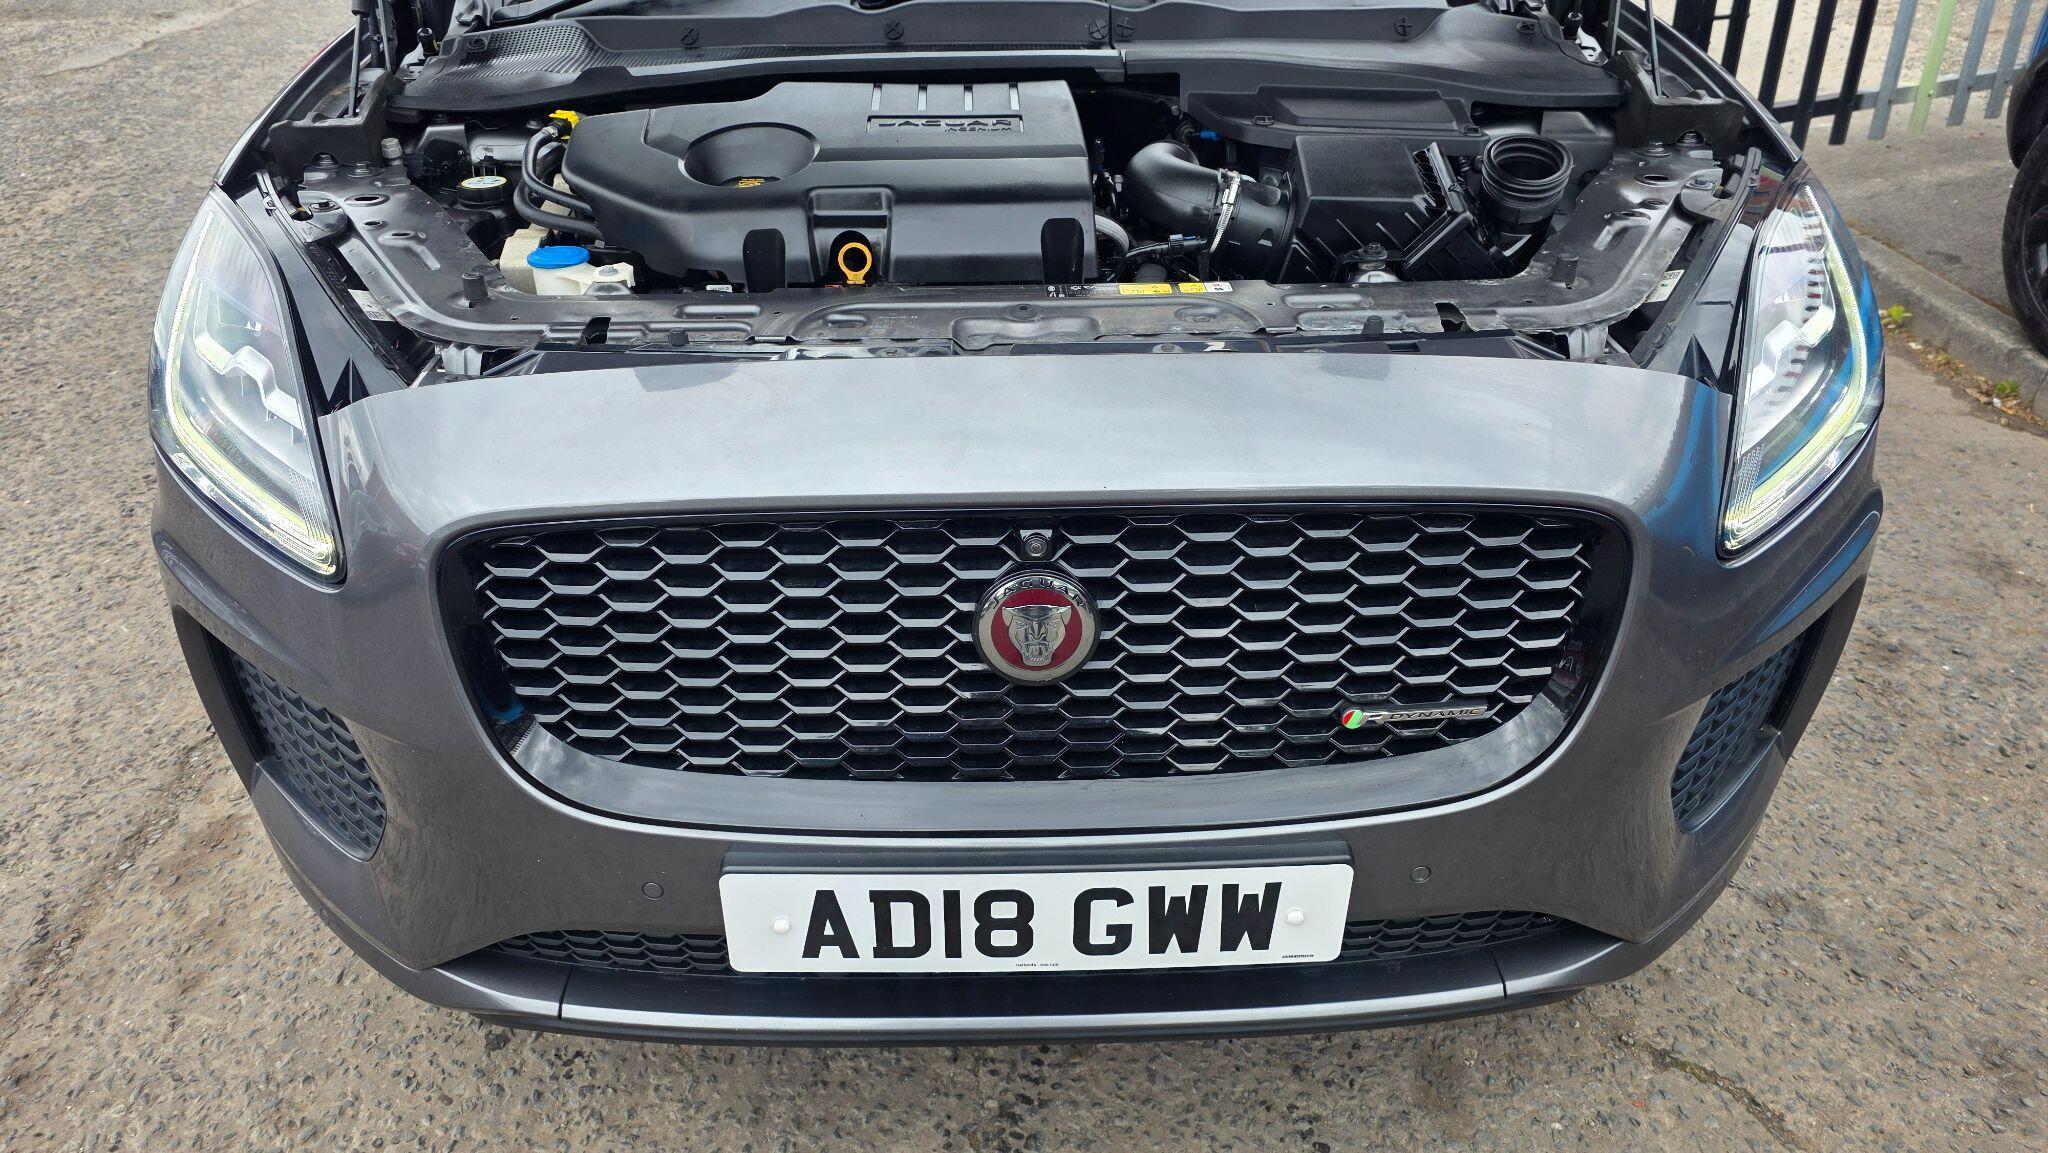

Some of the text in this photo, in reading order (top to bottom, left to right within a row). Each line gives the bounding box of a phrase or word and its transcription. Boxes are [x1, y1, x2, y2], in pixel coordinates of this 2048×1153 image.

[878, 119, 1012, 127] JAGUAR
[983, 578, 1086, 610] JAGUAR
[1389, 708, 1481, 720] DYNAMIC
[801, 881, 1283, 959] AD18 GWW
